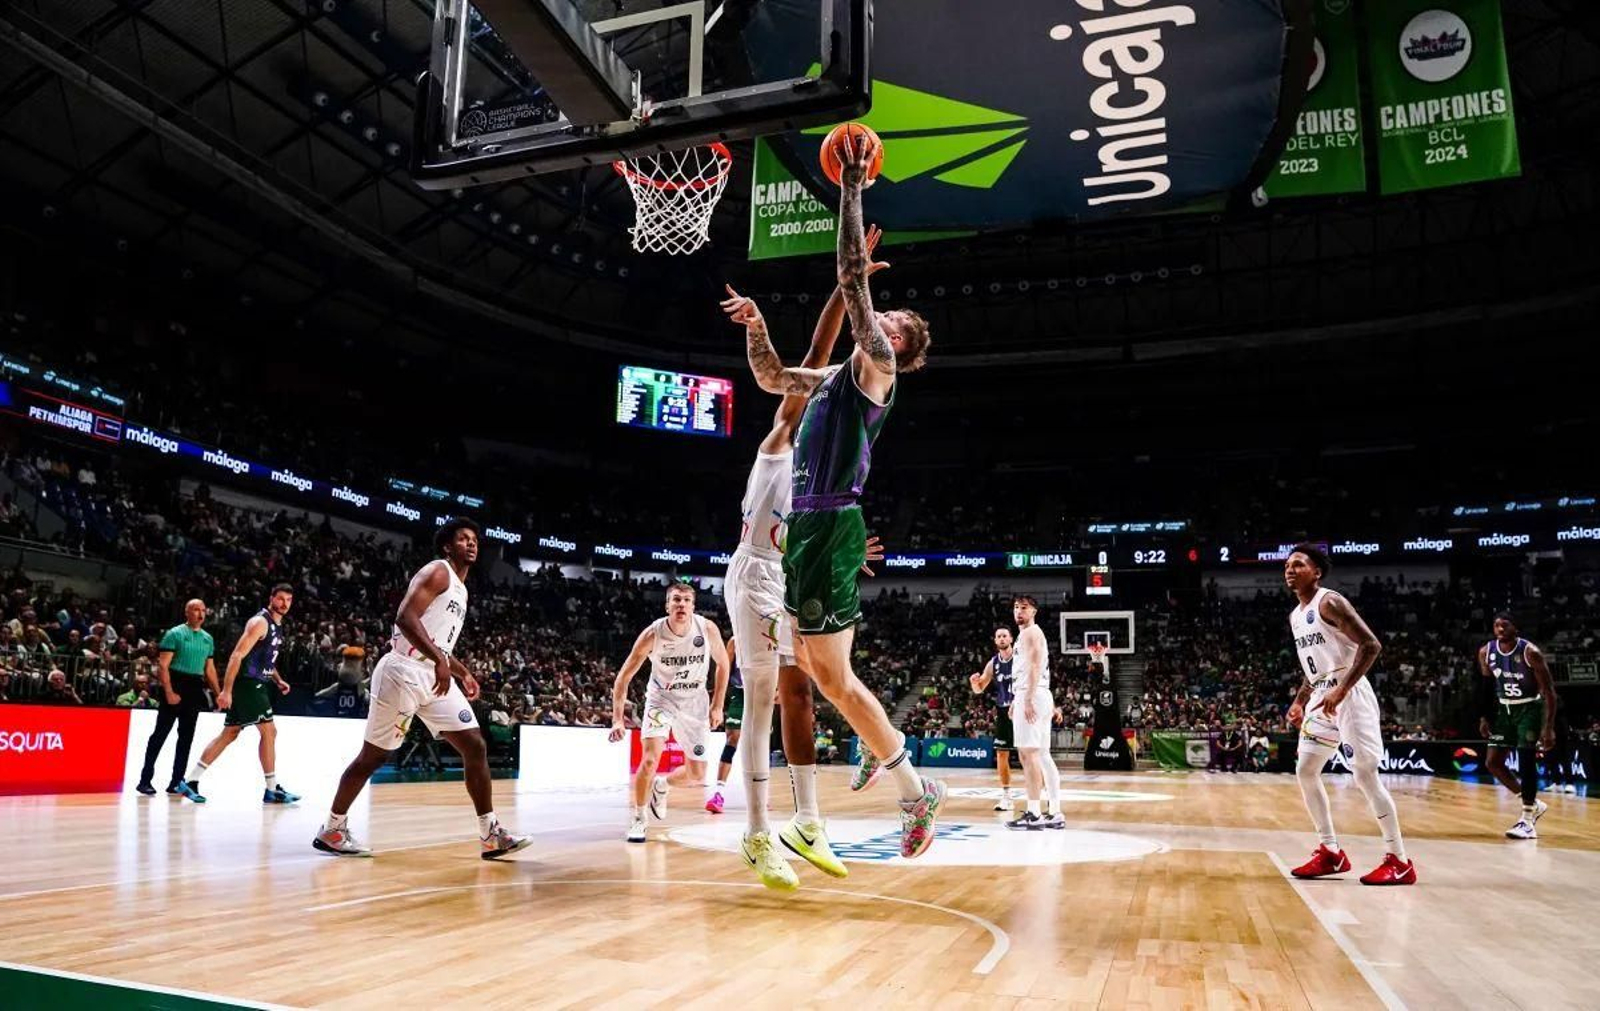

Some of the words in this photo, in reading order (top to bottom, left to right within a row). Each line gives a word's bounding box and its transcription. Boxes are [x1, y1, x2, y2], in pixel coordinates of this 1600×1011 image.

[1380, 88, 1506, 130] CAMPEONES
[1325, 132, 1359, 148] REY
[1428, 127, 1465, 145] BCL
[1425, 144, 1469, 164] 2024
[1280, 158, 1319, 174] 2023
[759, 202, 796, 218] COPA
[770, 218, 834, 237] 2000/2001
[29, 405, 92, 433] PETKIMSPOR
[59, 404, 93, 423] ALIAGA
[1030, 554, 1072, 565] UNICAJA
[1098, 551, 1107, 565] 0
[1134, 550, 1165, 564] 9:22
[1220, 546, 1229, 562] 2
[271, 650, 279, 663] 7
[1307, 655, 1317, 674] 8
[1503, 683, 1523, 697] 55
[948, 747, 987, 760] Unicaja
[1095, 750, 1119, 760] Unicaja
